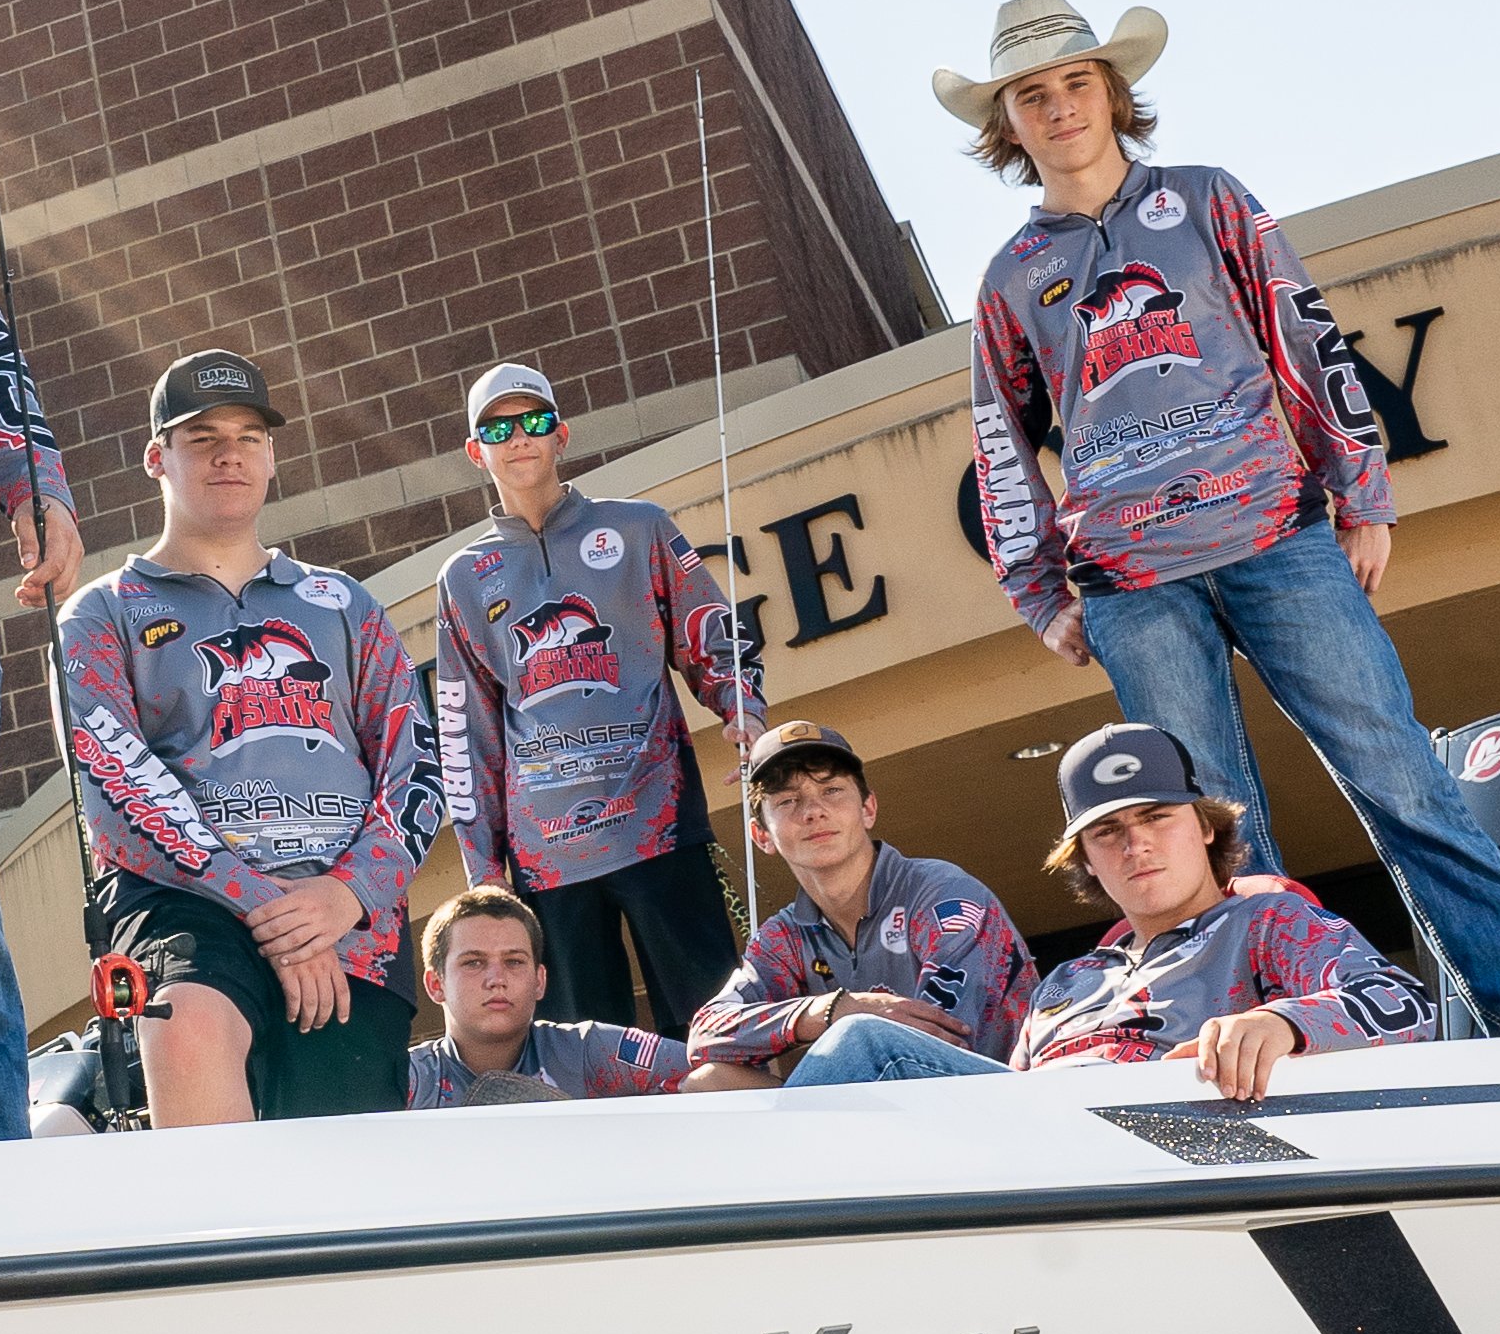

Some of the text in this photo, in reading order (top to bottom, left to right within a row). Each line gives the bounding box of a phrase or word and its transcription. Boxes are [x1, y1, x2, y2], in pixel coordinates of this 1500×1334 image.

[1147, 205, 1180, 220] Point
[1154, 191, 1167, 209] 5
[1139, 308, 1176, 329] CITY
[1082, 322, 1201, 395] FISHING
[197, 367, 248, 383] RAMBO
[1073, 412, 1138, 445] Team
[1073, 398, 1238, 464] GRANGER
[972, 402, 1040, 566] RAMBO
[1120, 470, 1248, 526] GOLF CARS
[1132, 493, 1239, 532] OF BEAUMONT
[587, 545, 618, 558] Point
[593, 532, 608, 551] 5
[436, 679, 479, 821] RAMBO
[513, 721, 652, 758] GRANGER
[196, 778, 278, 802] Team
[561, 813, 631, 841] BEAUMONT
[278, 839, 300, 850] Jeep
[893, 912, 904, 929] 5
